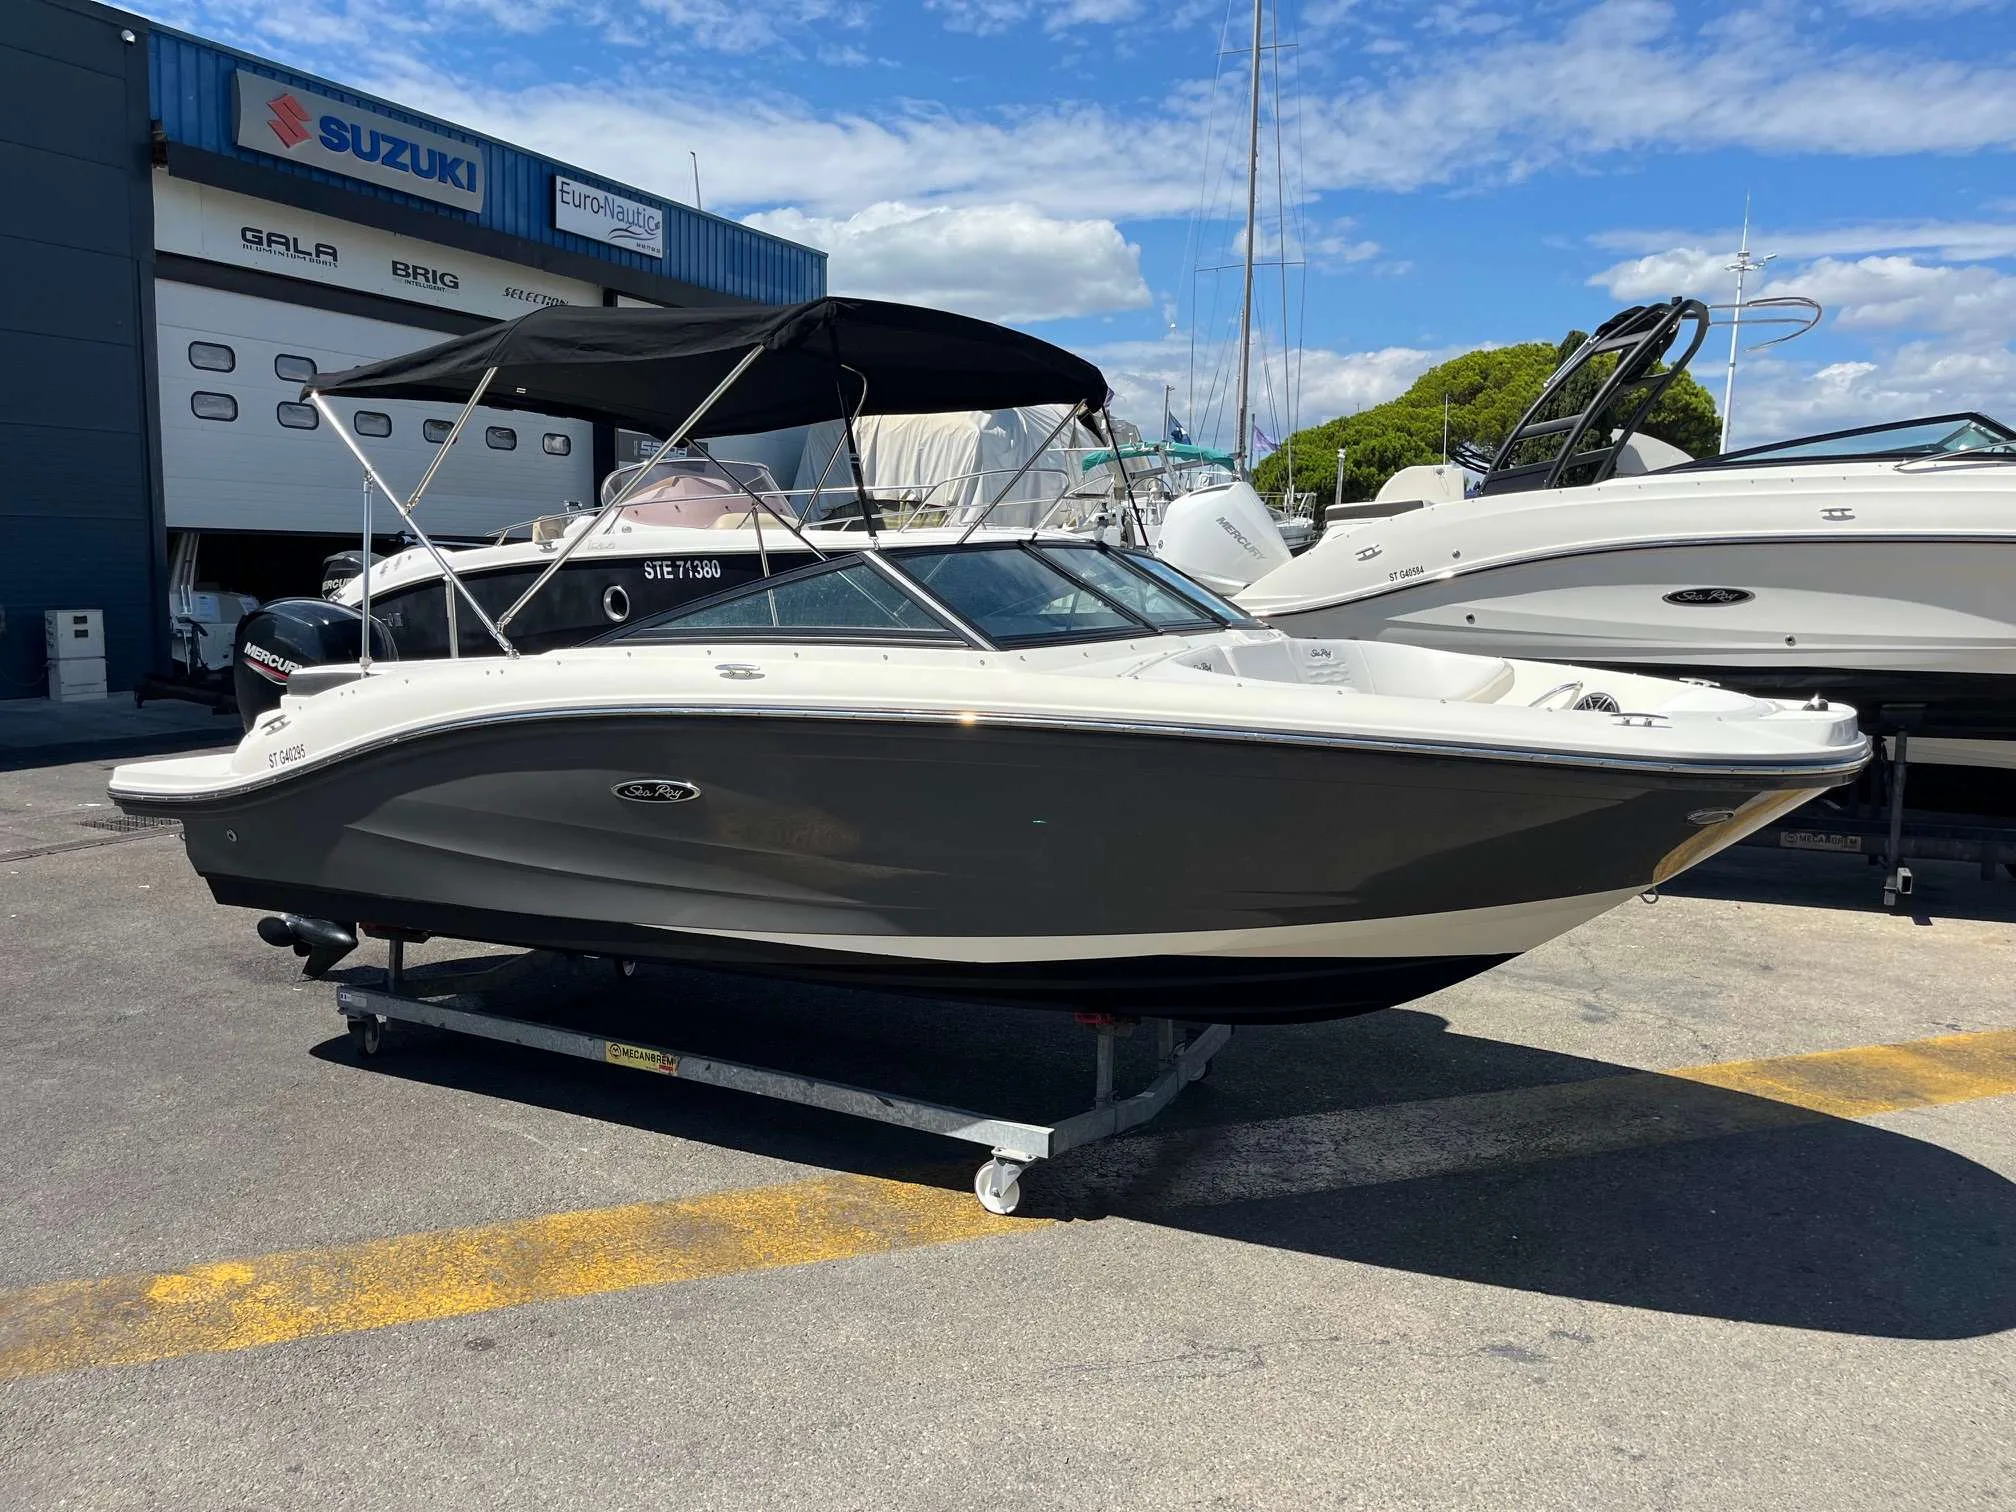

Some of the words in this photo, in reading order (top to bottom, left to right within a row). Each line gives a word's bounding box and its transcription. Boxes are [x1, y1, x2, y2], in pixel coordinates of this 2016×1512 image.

[319, 115, 477, 193] SUZUKI
[559, 181, 656, 232] Euro-Nautic
[241, 227, 338, 263] GALA
[391, 260, 459, 290] BRIG
[404, 279, 446, 293] INTELLIGENT
[1216, 517, 1267, 560] MERCURY
[644, 561, 674, 579] STE
[676, 560, 722, 579] 71380
[1389, 572, 1398, 582] ST
[1400, 565, 1425, 579] G40584
[1677, 591, 1705, 601] Sea
[1706, 589, 1739, 603] Ray
[244, 641, 303, 674] MERCUR
[268, 753, 278, 769] ST
[280, 743, 306, 765] G40295
[624, 785, 653, 797] Sea
[654, 784, 684, 800] Ray
[622, 1047, 674, 1066] MECANBREM
